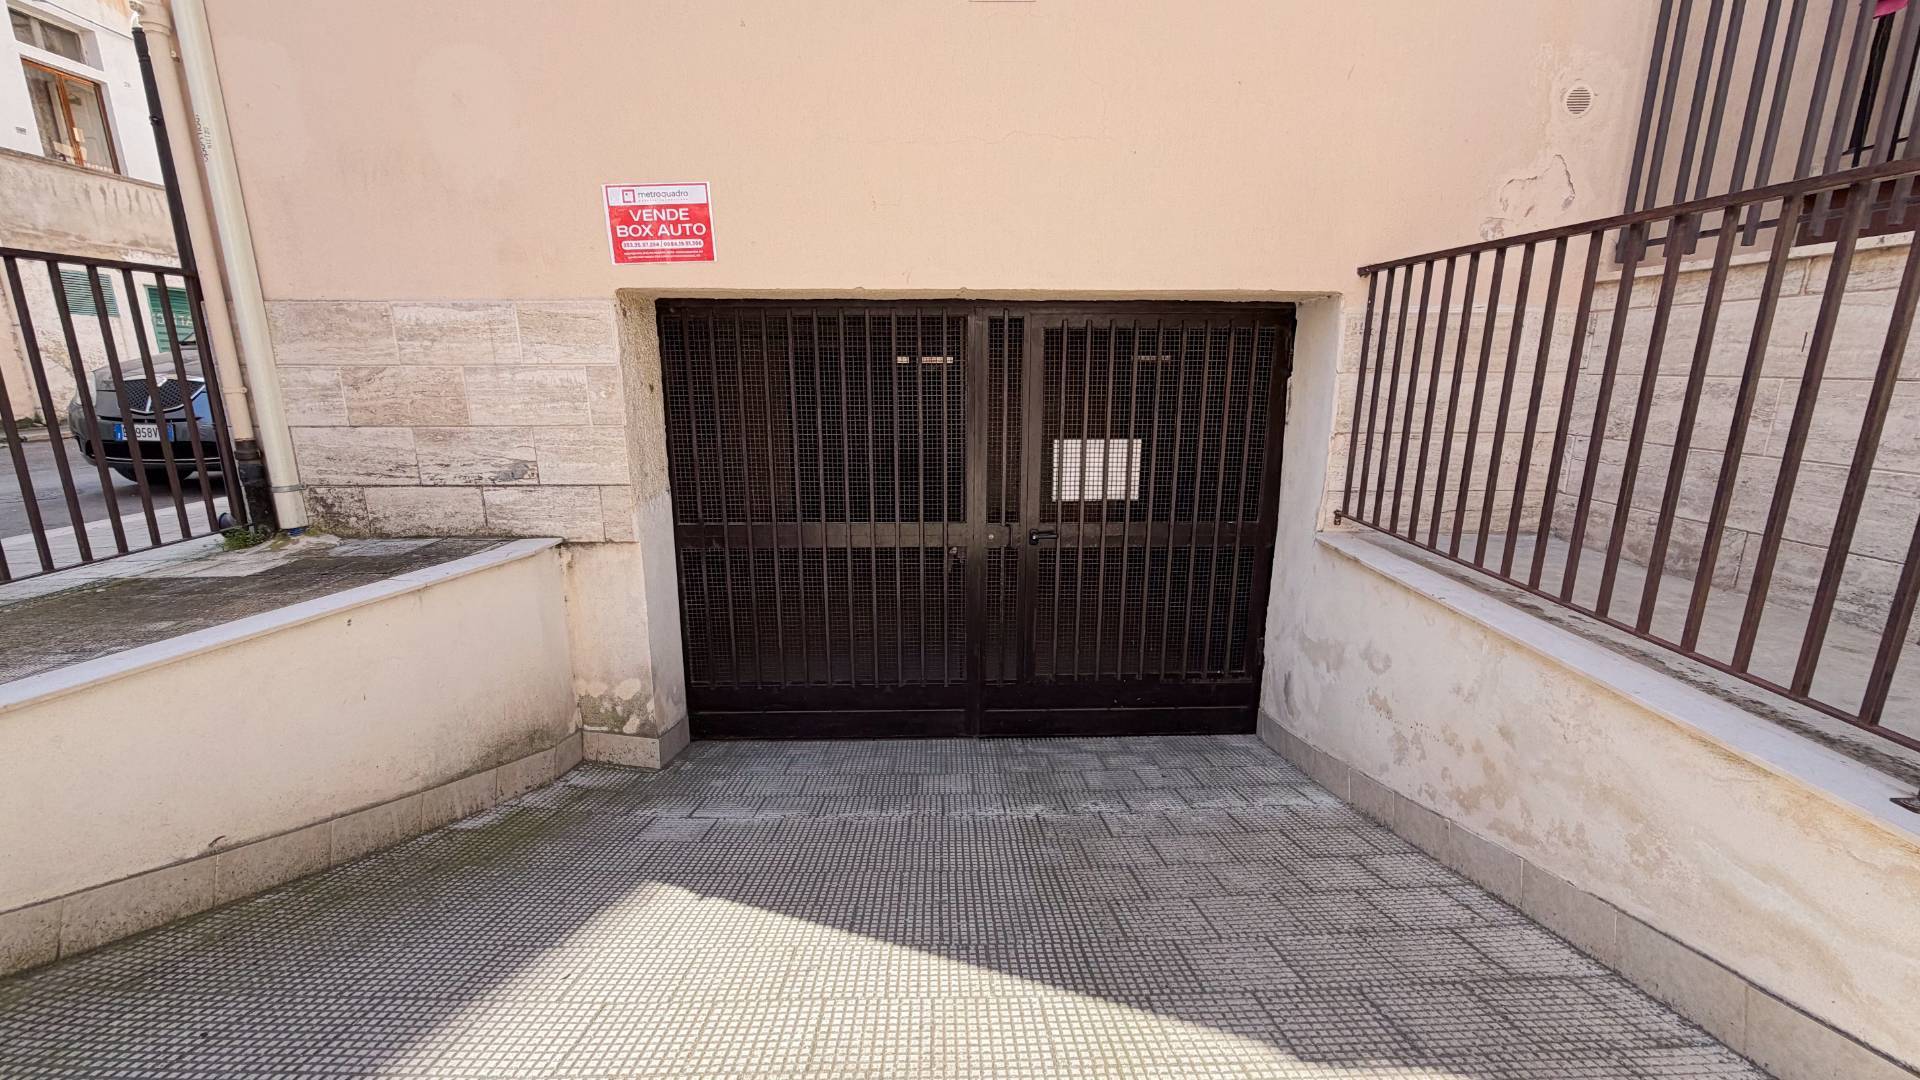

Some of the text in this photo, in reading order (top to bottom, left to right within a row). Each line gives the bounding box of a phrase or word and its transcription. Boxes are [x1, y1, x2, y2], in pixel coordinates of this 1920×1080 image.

[638, 190, 688, 199] metroquadro
[629, 208, 690, 221] VENDE
[616, 223, 706, 237] BOX AUTO
